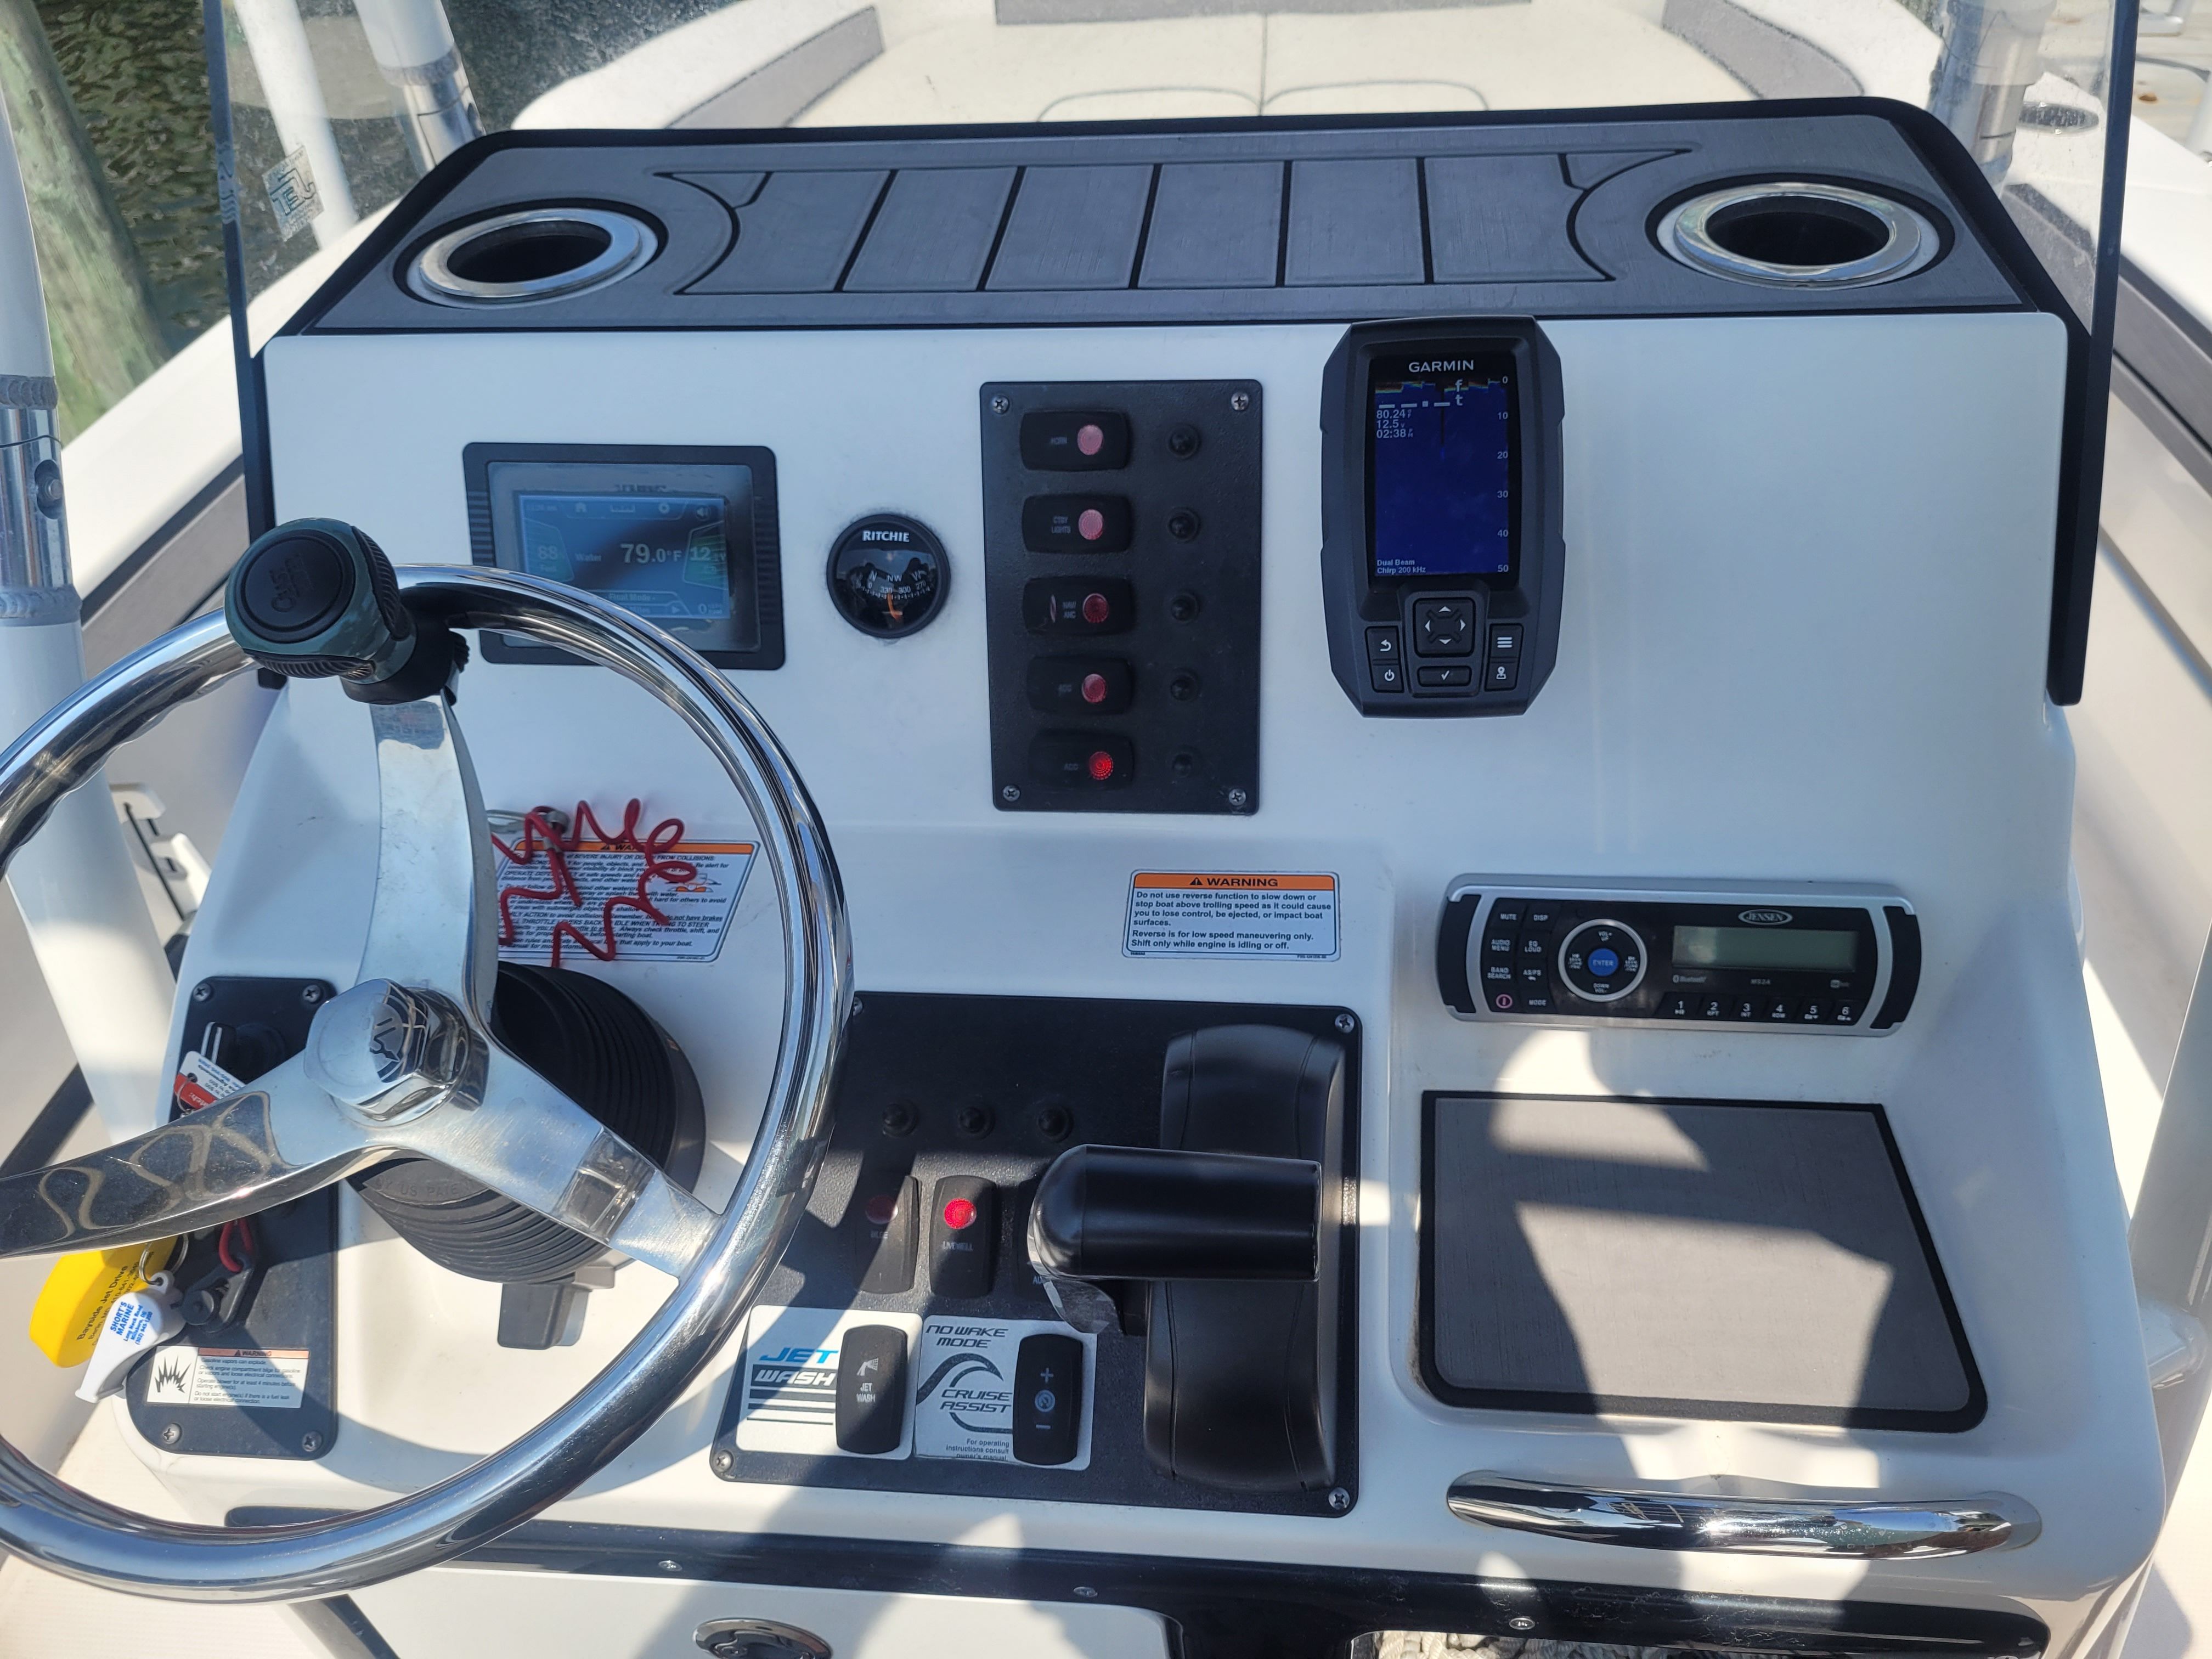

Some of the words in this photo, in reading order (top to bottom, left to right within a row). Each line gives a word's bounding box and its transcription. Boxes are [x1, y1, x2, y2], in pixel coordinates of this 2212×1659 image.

[1408, 359, 1474, 373] GARMIN
[1502, 376, 1508, 384] 0
[1376, 409, 1406, 419] 80.24
[1497, 411, 1508, 420] 10
[1376, 419, 1399, 428] 12.5
[1376, 428, 1406, 438] 02:38
[1497, 451, 1508, 459] 20
[1497, 490, 1509, 499] 30
[862, 529, 910, 543] RITCHIE
[1497, 529, 1509, 538] 40
[1497, 565, 1509, 573] 50
[868, 570, 878, 582] N
[916, 580, 927, 590] 270
[1207, 878, 1278, 887] WARNING
[1215, 893, 1249, 901] function
[1203, 902, 1232, 911] trolling
[1234, 902, 1260, 911] speed
[1182, 911, 1214, 919] control,
[1228, 911, 1261, 920] ejected,
[1274, 912, 1302, 921] impact
[1500, 913, 1517, 921] MUTE
[1745, 912, 1786, 922] JENSEN
[1133, 919, 1171, 927] surfaces.
[1193, 930, 1207, 939] low
[1209, 932, 1234, 940] speed
[1237, 933, 1291, 941] maneuvering
[1294, 933, 1314, 942] only.
[1131, 939, 1151, 947] Shift
[1153, 940, 1171, 949] only
[1198, 940, 1226, 949] engine
[1238, 941, 1262, 950] idling
[1275, 941, 1290, 950] off.
[1487, 972, 1511, 980] SEARCH
[1678, 1000, 1685, 1009] 1
[1709, 1002, 1718, 1011] 2
[1742, 1003, 1751, 1012] 3
[1775, 1004, 1784, 1013] 4
[1810, 1005, 1818, 1014] 5
[1842, 1006, 1849, 1015] 6
[76, 1305, 104, 1340] Bayside
[99, 1289, 114, 1304] Jet
[108, 1265, 129, 1289] Drive
[110, 1301, 127, 1332] SHORT'S
[116, 1304, 134, 1336] MARINE
[925, 1324, 955, 1335] NO
[954, 1325, 1009, 1338] WAKE
[936, 1337, 992, 1349] MODE
[759, 1347, 839, 1364] JET
[754, 1369, 837, 1386] WASH
[860, 1383, 873, 1393] JET
[856, 1393, 876, 1403] WASH
[941, 1389, 1013, 1402] CRUISE
[939, 1401, 1012, 1414] ASSIST
[979, 1439, 1010, 1448] operating
[946, 1444, 985, 1453] instructions
